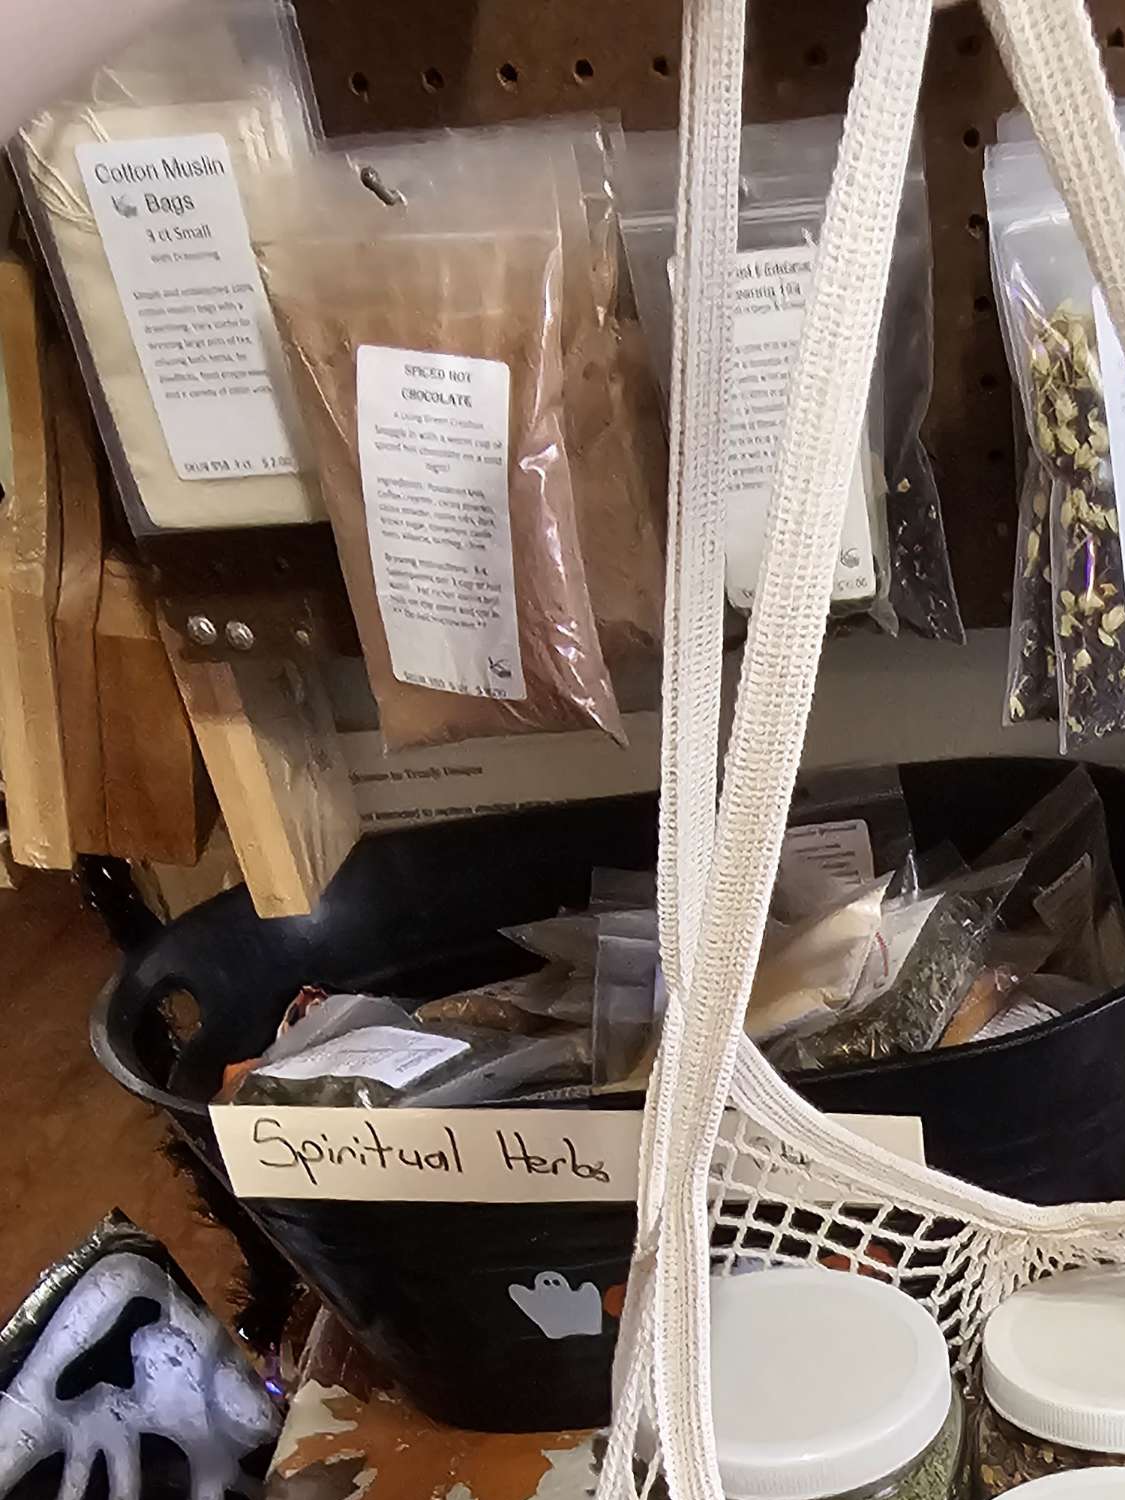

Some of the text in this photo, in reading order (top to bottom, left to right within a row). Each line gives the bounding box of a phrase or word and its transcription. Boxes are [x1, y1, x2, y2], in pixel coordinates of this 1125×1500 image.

[95, 155, 225, 185] Cotton Muslin
[144, 192, 195, 216] Bags
[174, 224, 212, 241] Small
[404, 364, 445, 380] SPICED
[401, 387, 473, 408] CHOCOLATE
[253, 1118, 611, 1186] Spiritual Herbs
